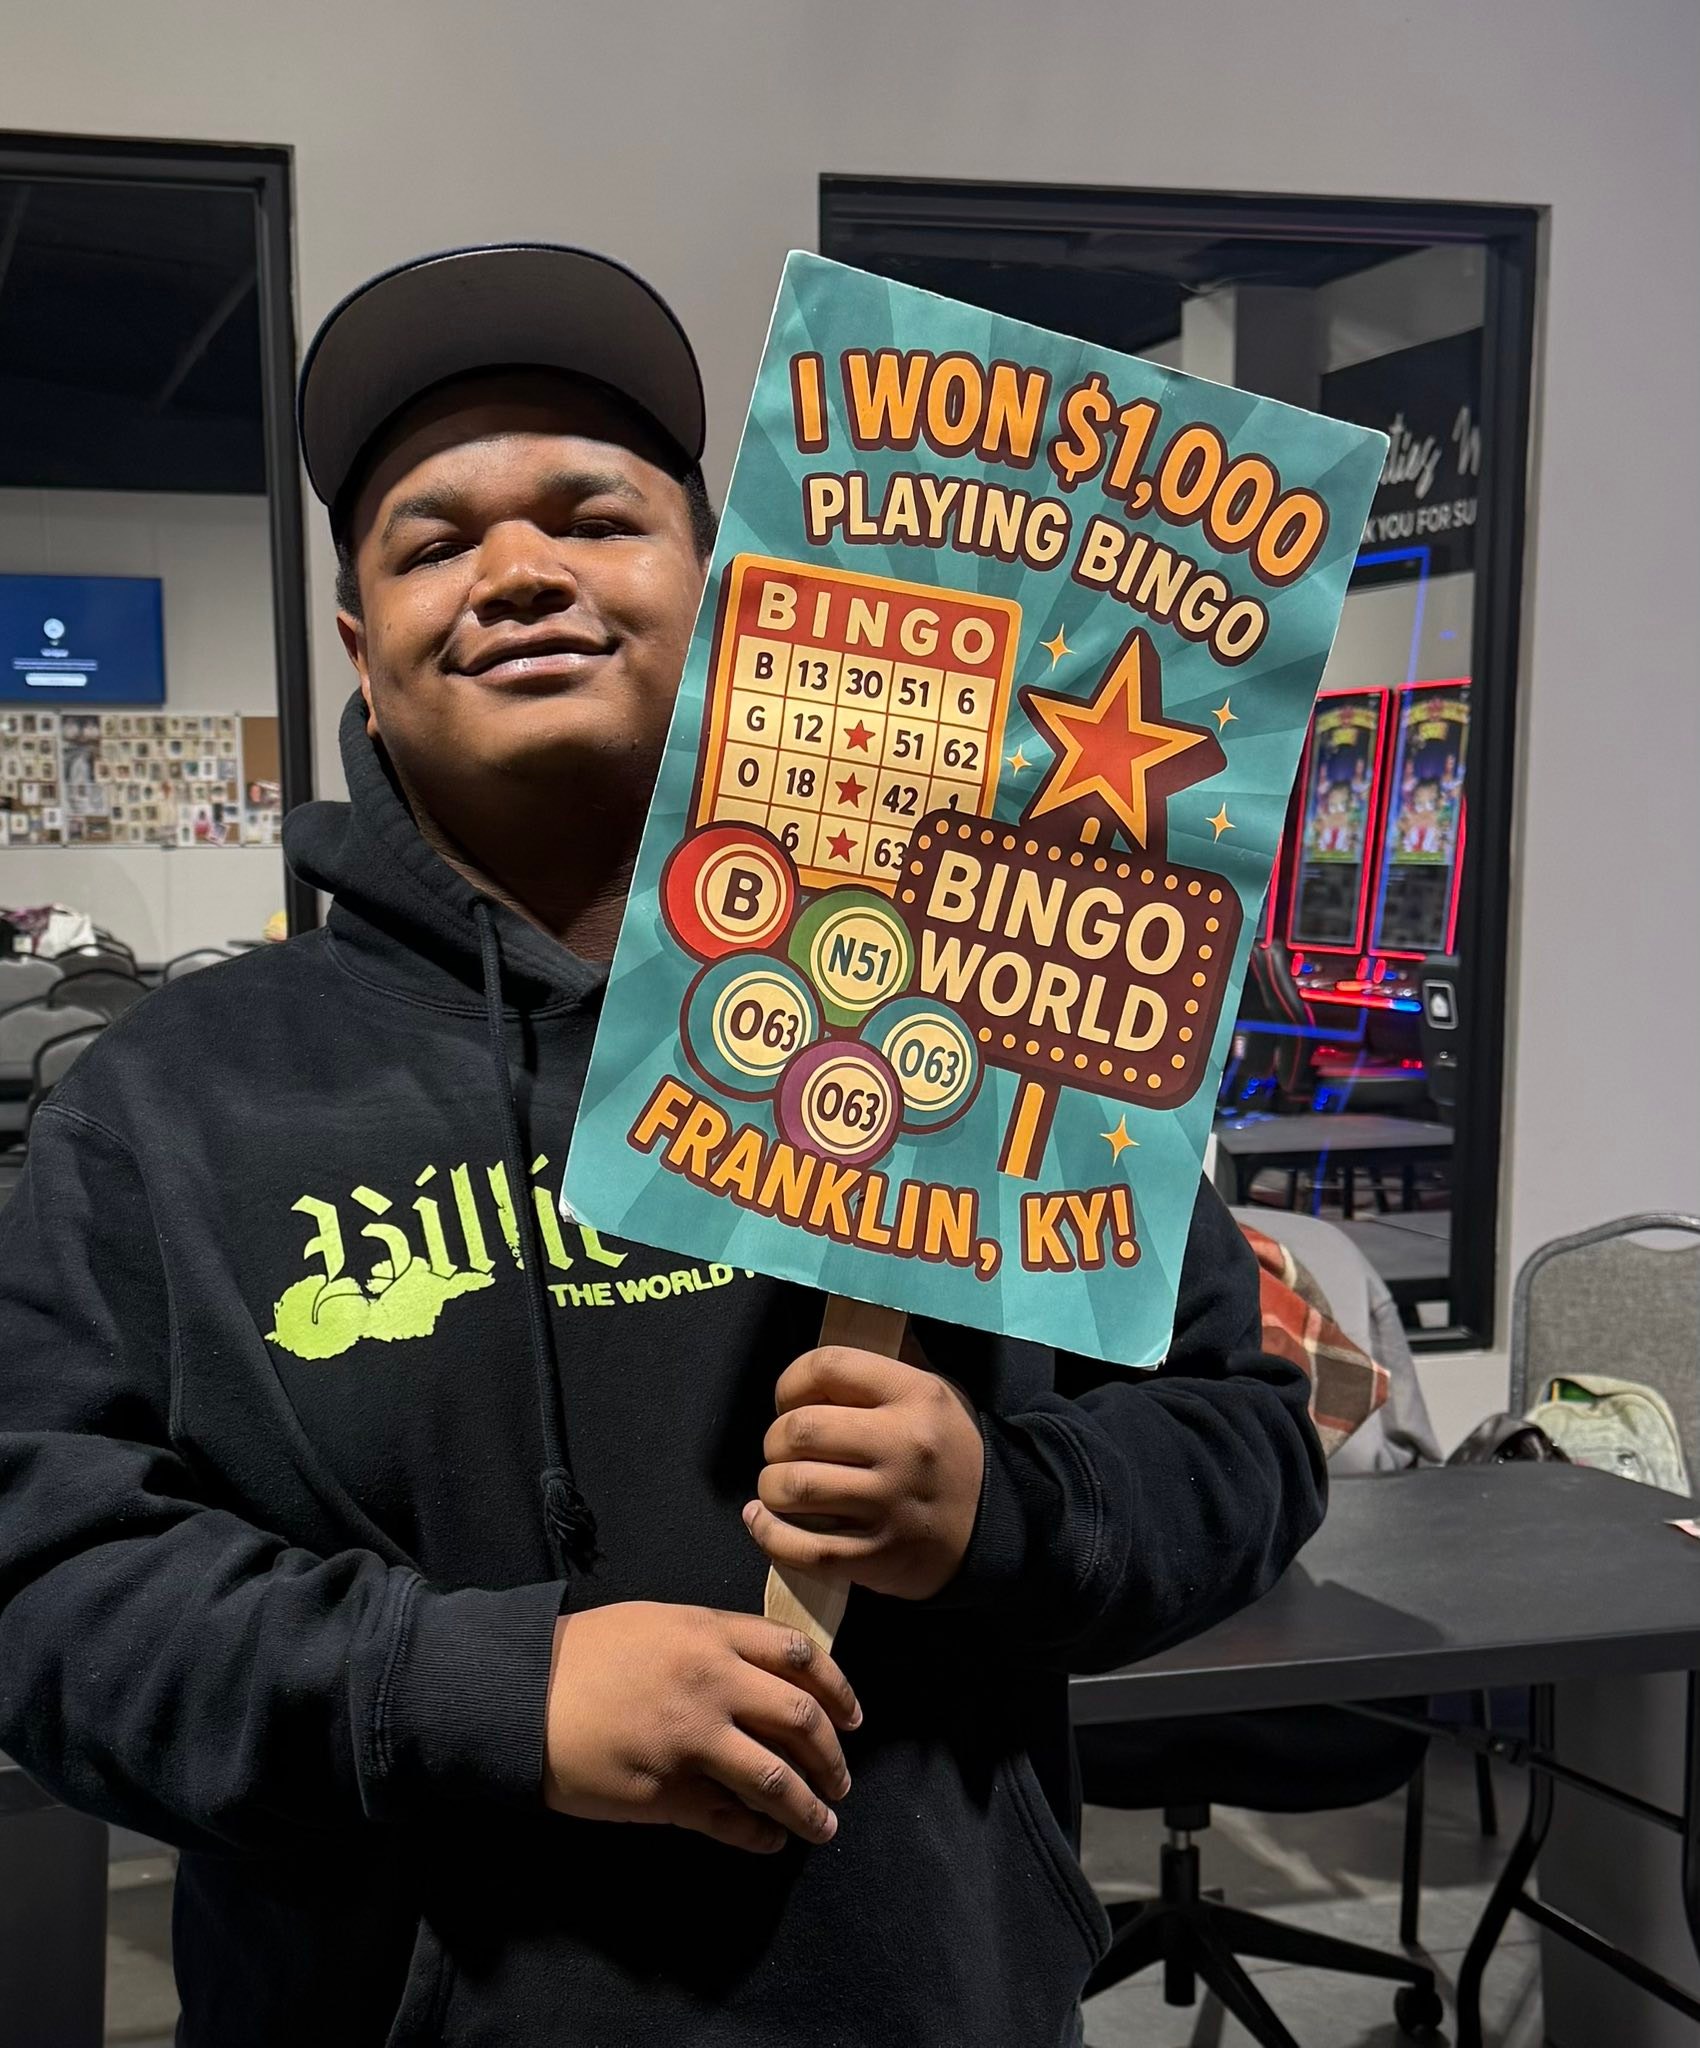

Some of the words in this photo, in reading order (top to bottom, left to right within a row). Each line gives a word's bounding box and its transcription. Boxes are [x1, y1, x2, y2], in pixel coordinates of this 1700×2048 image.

[794, 355, 825, 446] I
[845, 350, 1048, 462] WON
[1052, 376, 1326, 579] $1,000
[1379, 510, 1414, 540] YOU
[1416, 504, 1450, 535] FOR
[808, 475, 1070, 564] PLAYING
[1077, 519, 1265, 660] BINGO
[756, 579, 996, 666] BINGO
[753, 651, 775, 681] B
[797, 659, 830, 692] 13
[844, 667, 884, 700] 30
[897, 677, 931, 709] 51
[956, 687, 977, 716] 6
[745, 705, 766, 732] G
[792, 712, 825, 744] 12
[892, 728, 926, 761] 51
[942, 738, 980, 772] 62
[785, 767, 816, 799] 18
[881, 784, 919, 817] 42
[780, 821, 801, 853] 6
[873, 837, 908, 869] 63
[720, 867, 763, 922] B
[925, 849, 1186, 975] BINGO
[826, 932, 892, 986] N51
[920, 929, 1168, 1053] WORLD
[729, 998, 799, 1054] O63
[899, 1038, 960, 1089] O63
[816, 1080, 881, 1133] O63
[633, 1079, 999, 1274] FRANKLIN,
[1025, 1188, 1136, 1264] KY!
[547, 1283, 616, 1308] THE
[619, 1263, 734, 1305] WORLD
